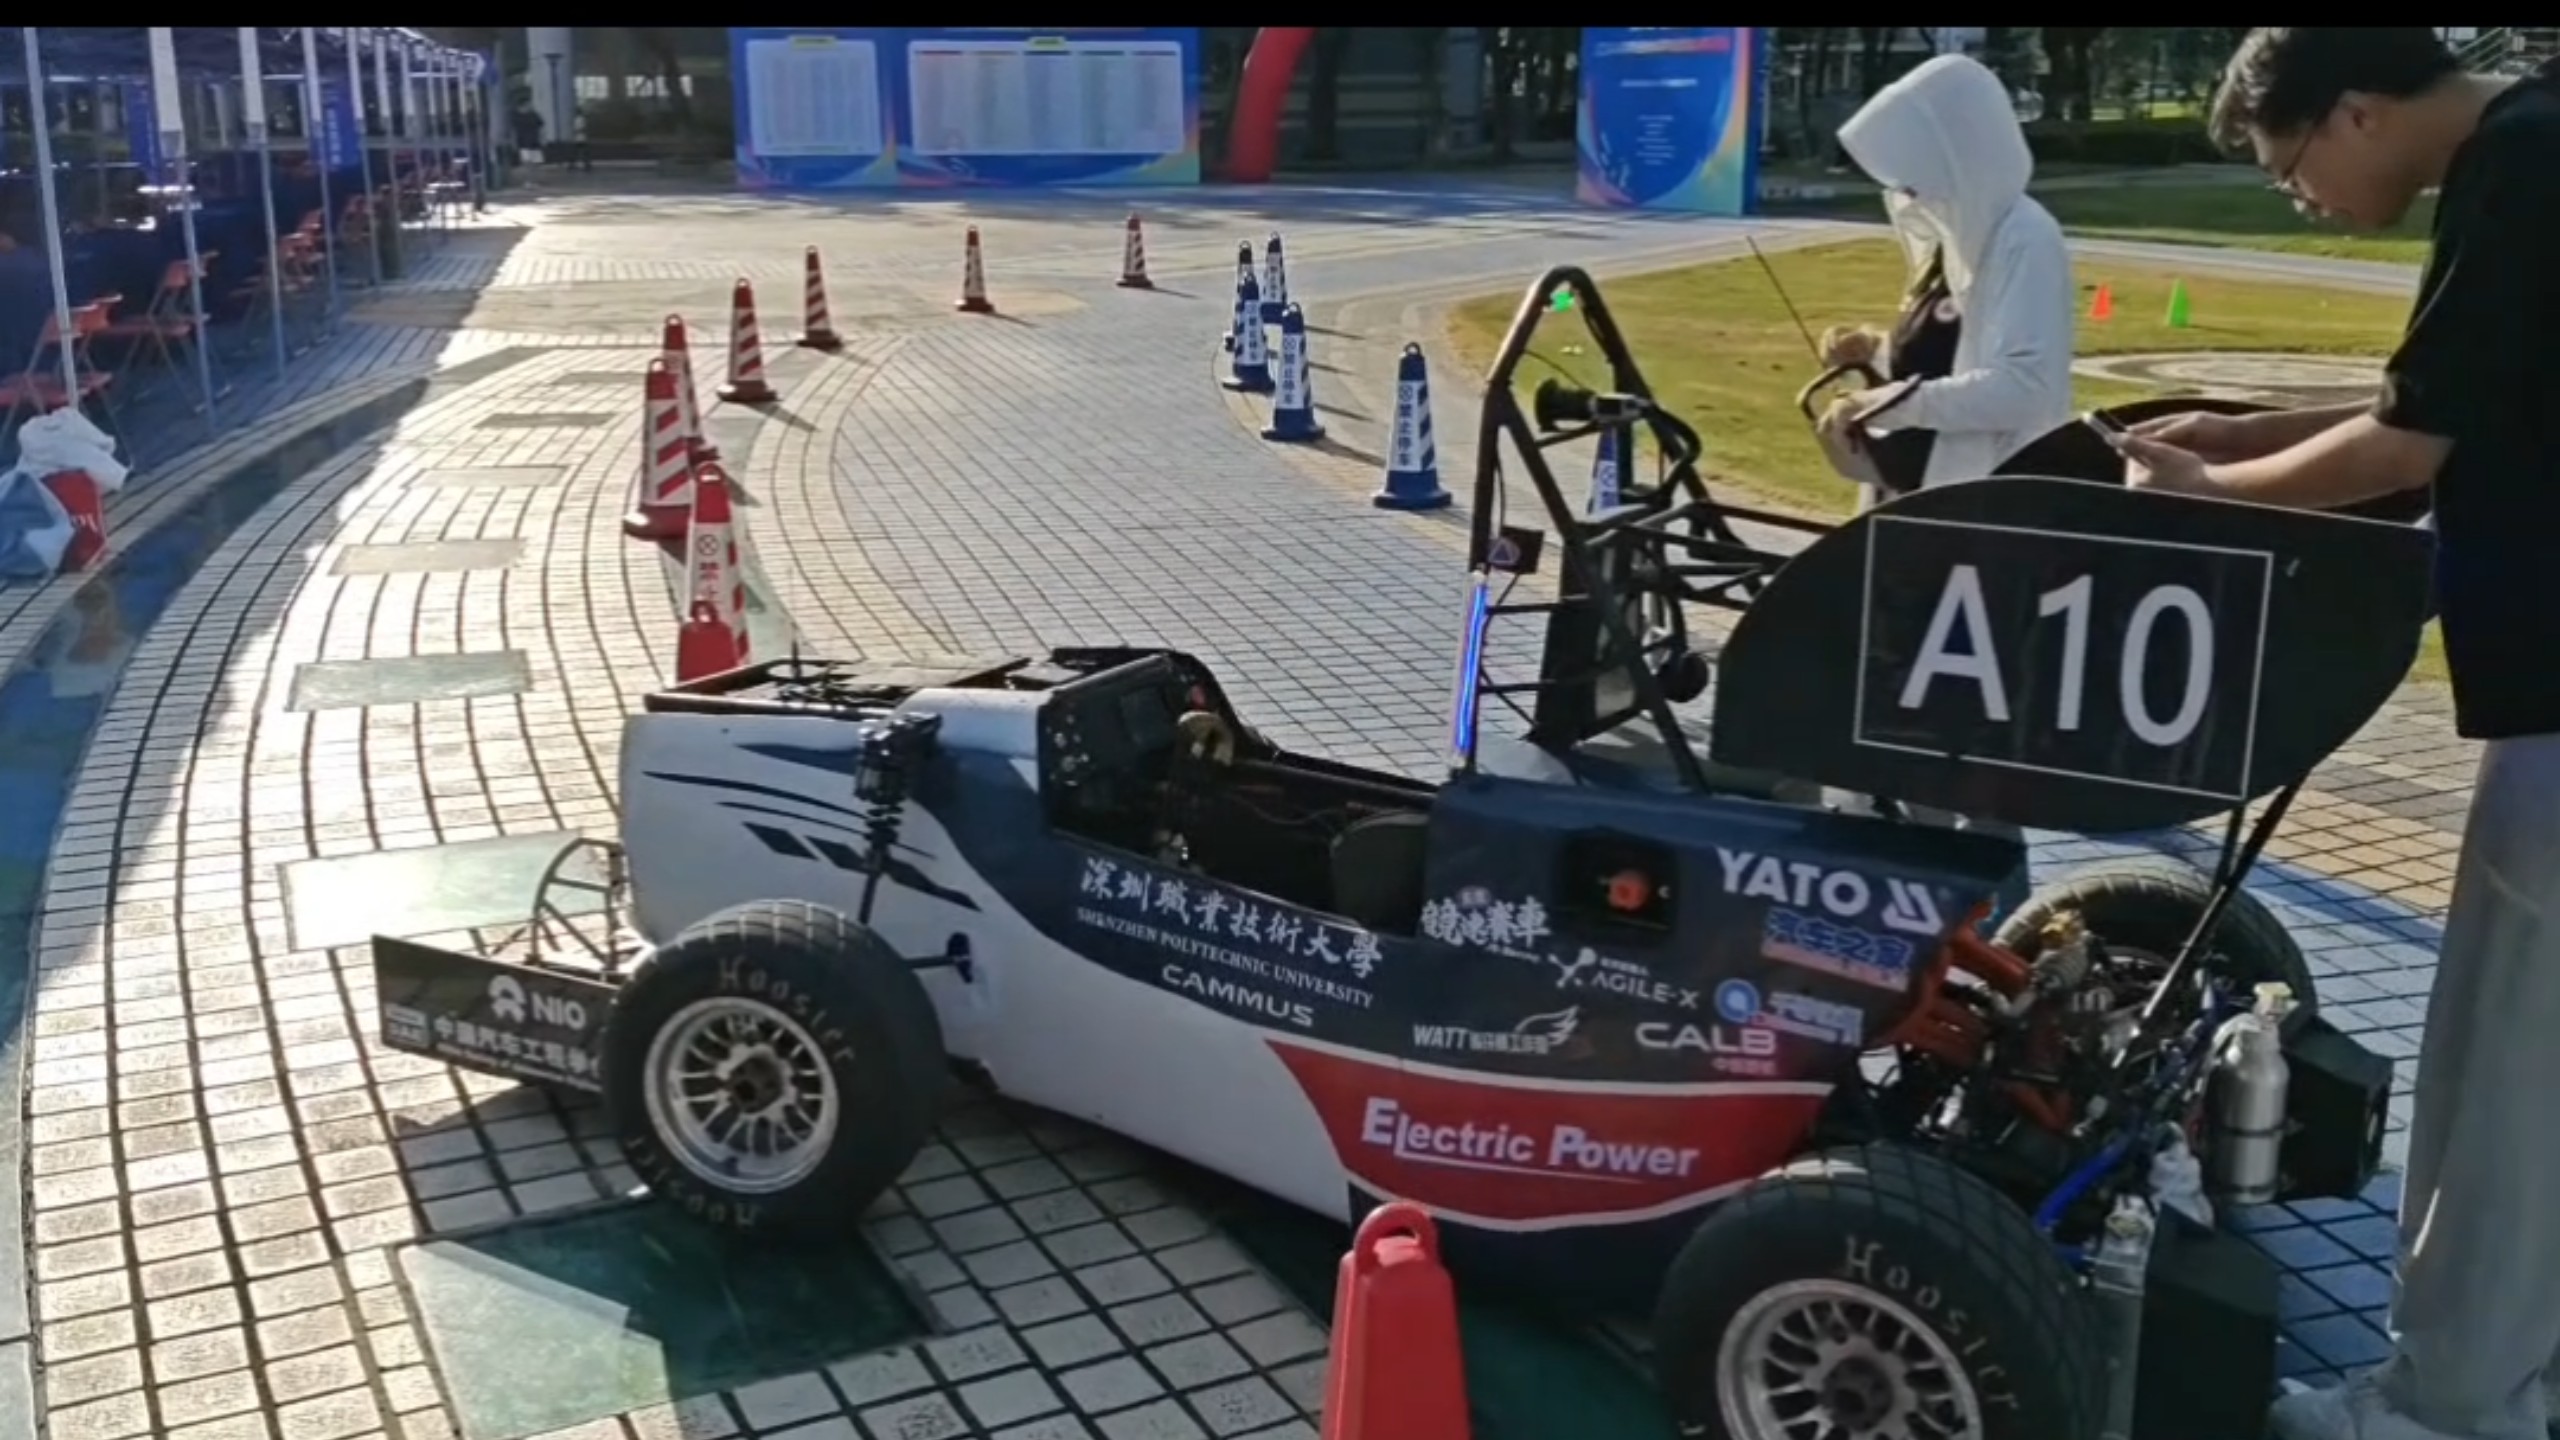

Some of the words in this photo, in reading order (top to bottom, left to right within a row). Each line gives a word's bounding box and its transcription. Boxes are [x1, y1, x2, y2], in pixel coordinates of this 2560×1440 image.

[1899, 564, 2216, 747] A10
[1716, 847, 1870, 917] YATO
[1077, 907, 1158, 942] SHENZHEN
[1160, 931, 1271, 977] POLYTECHNIC
[1274, 964, 1374, 1009] UNIVERSITY
[1591, 971, 1699, 1010] AGILE-X
[531, 992, 586, 1030] NIO
[1161, 963, 1315, 1028] CAMMUS
[1413, 1023, 1468, 1050] WATT
[1635, 1022, 1776, 1056] CALB
[1361, 1096, 1535, 1162] Electric
[1548, 1124, 1699, 1176] Power
[1845, 1234, 2019, 1409] Hoosier
